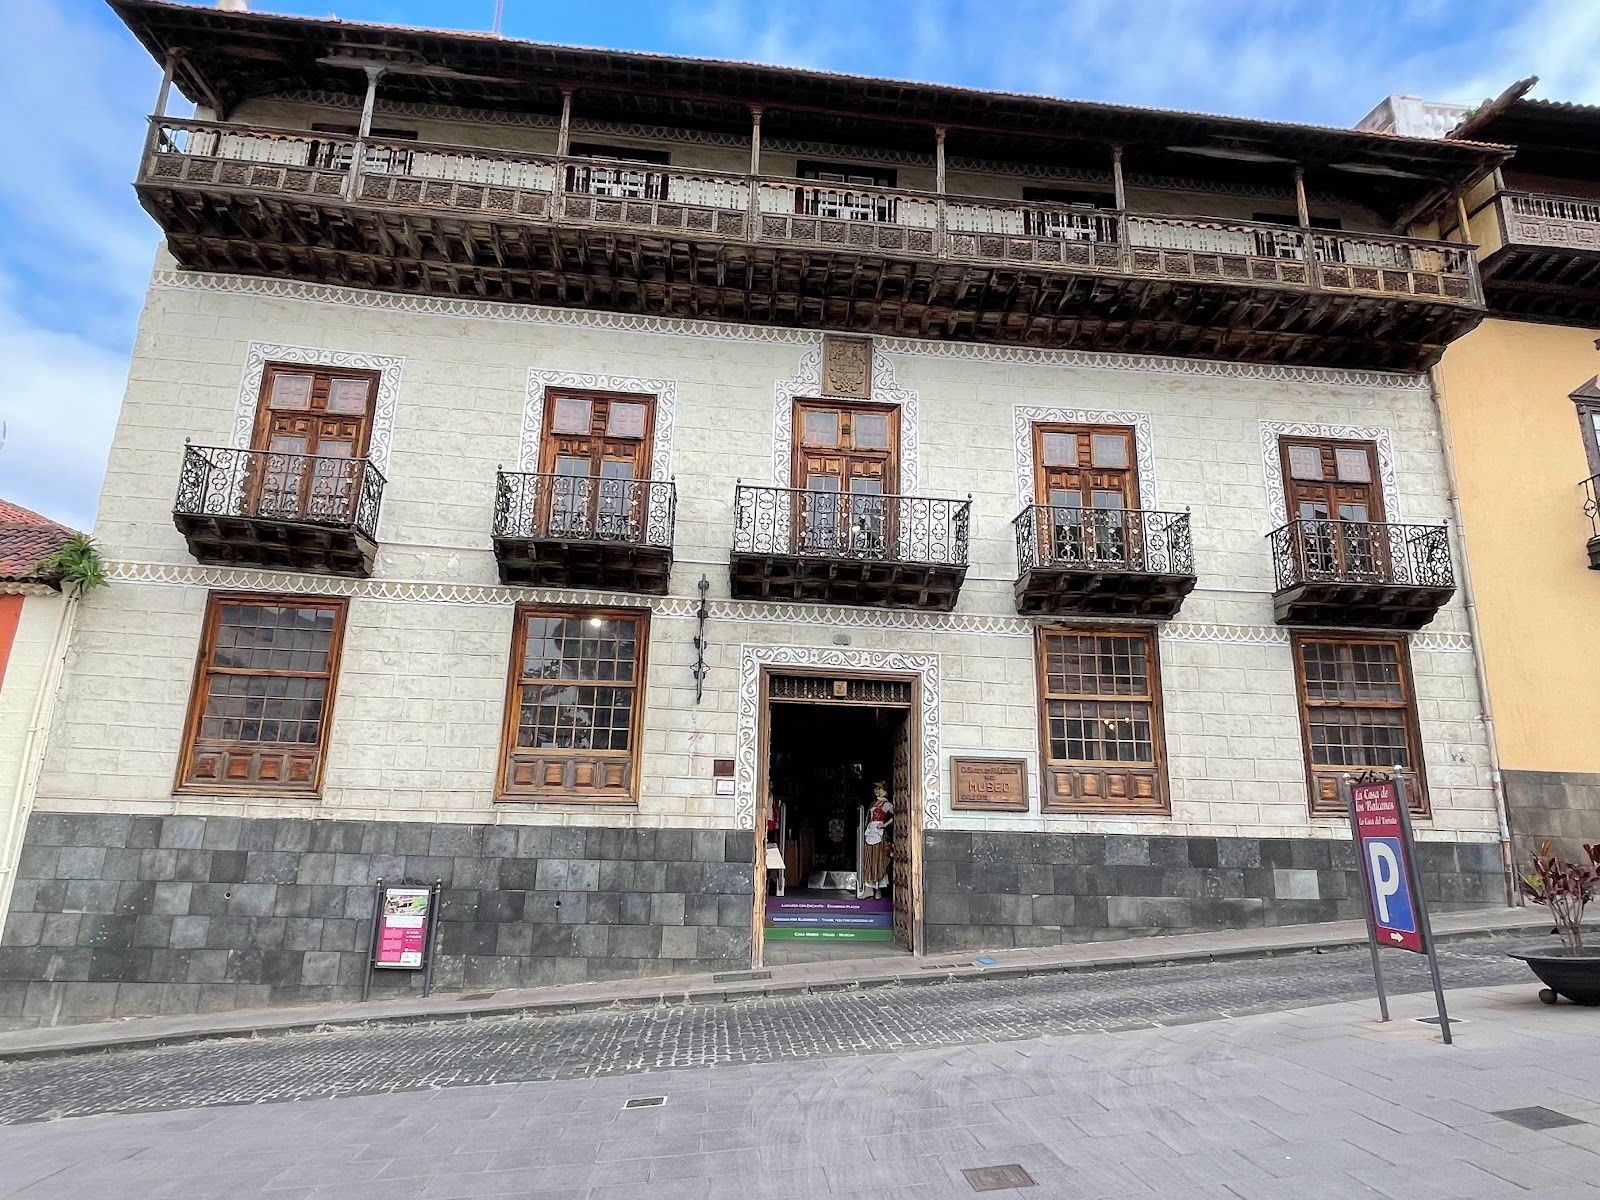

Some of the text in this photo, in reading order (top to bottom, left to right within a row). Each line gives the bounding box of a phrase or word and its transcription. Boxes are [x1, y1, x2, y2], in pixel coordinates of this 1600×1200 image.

[837, 683, 844, 694] 3
[968, 780, 1011, 793] MUSEO
[1355, 785, 1389, 800] La Casa de
[1355, 798, 1395, 812] los Balcones
[1368, 842, 1400, 924] P
